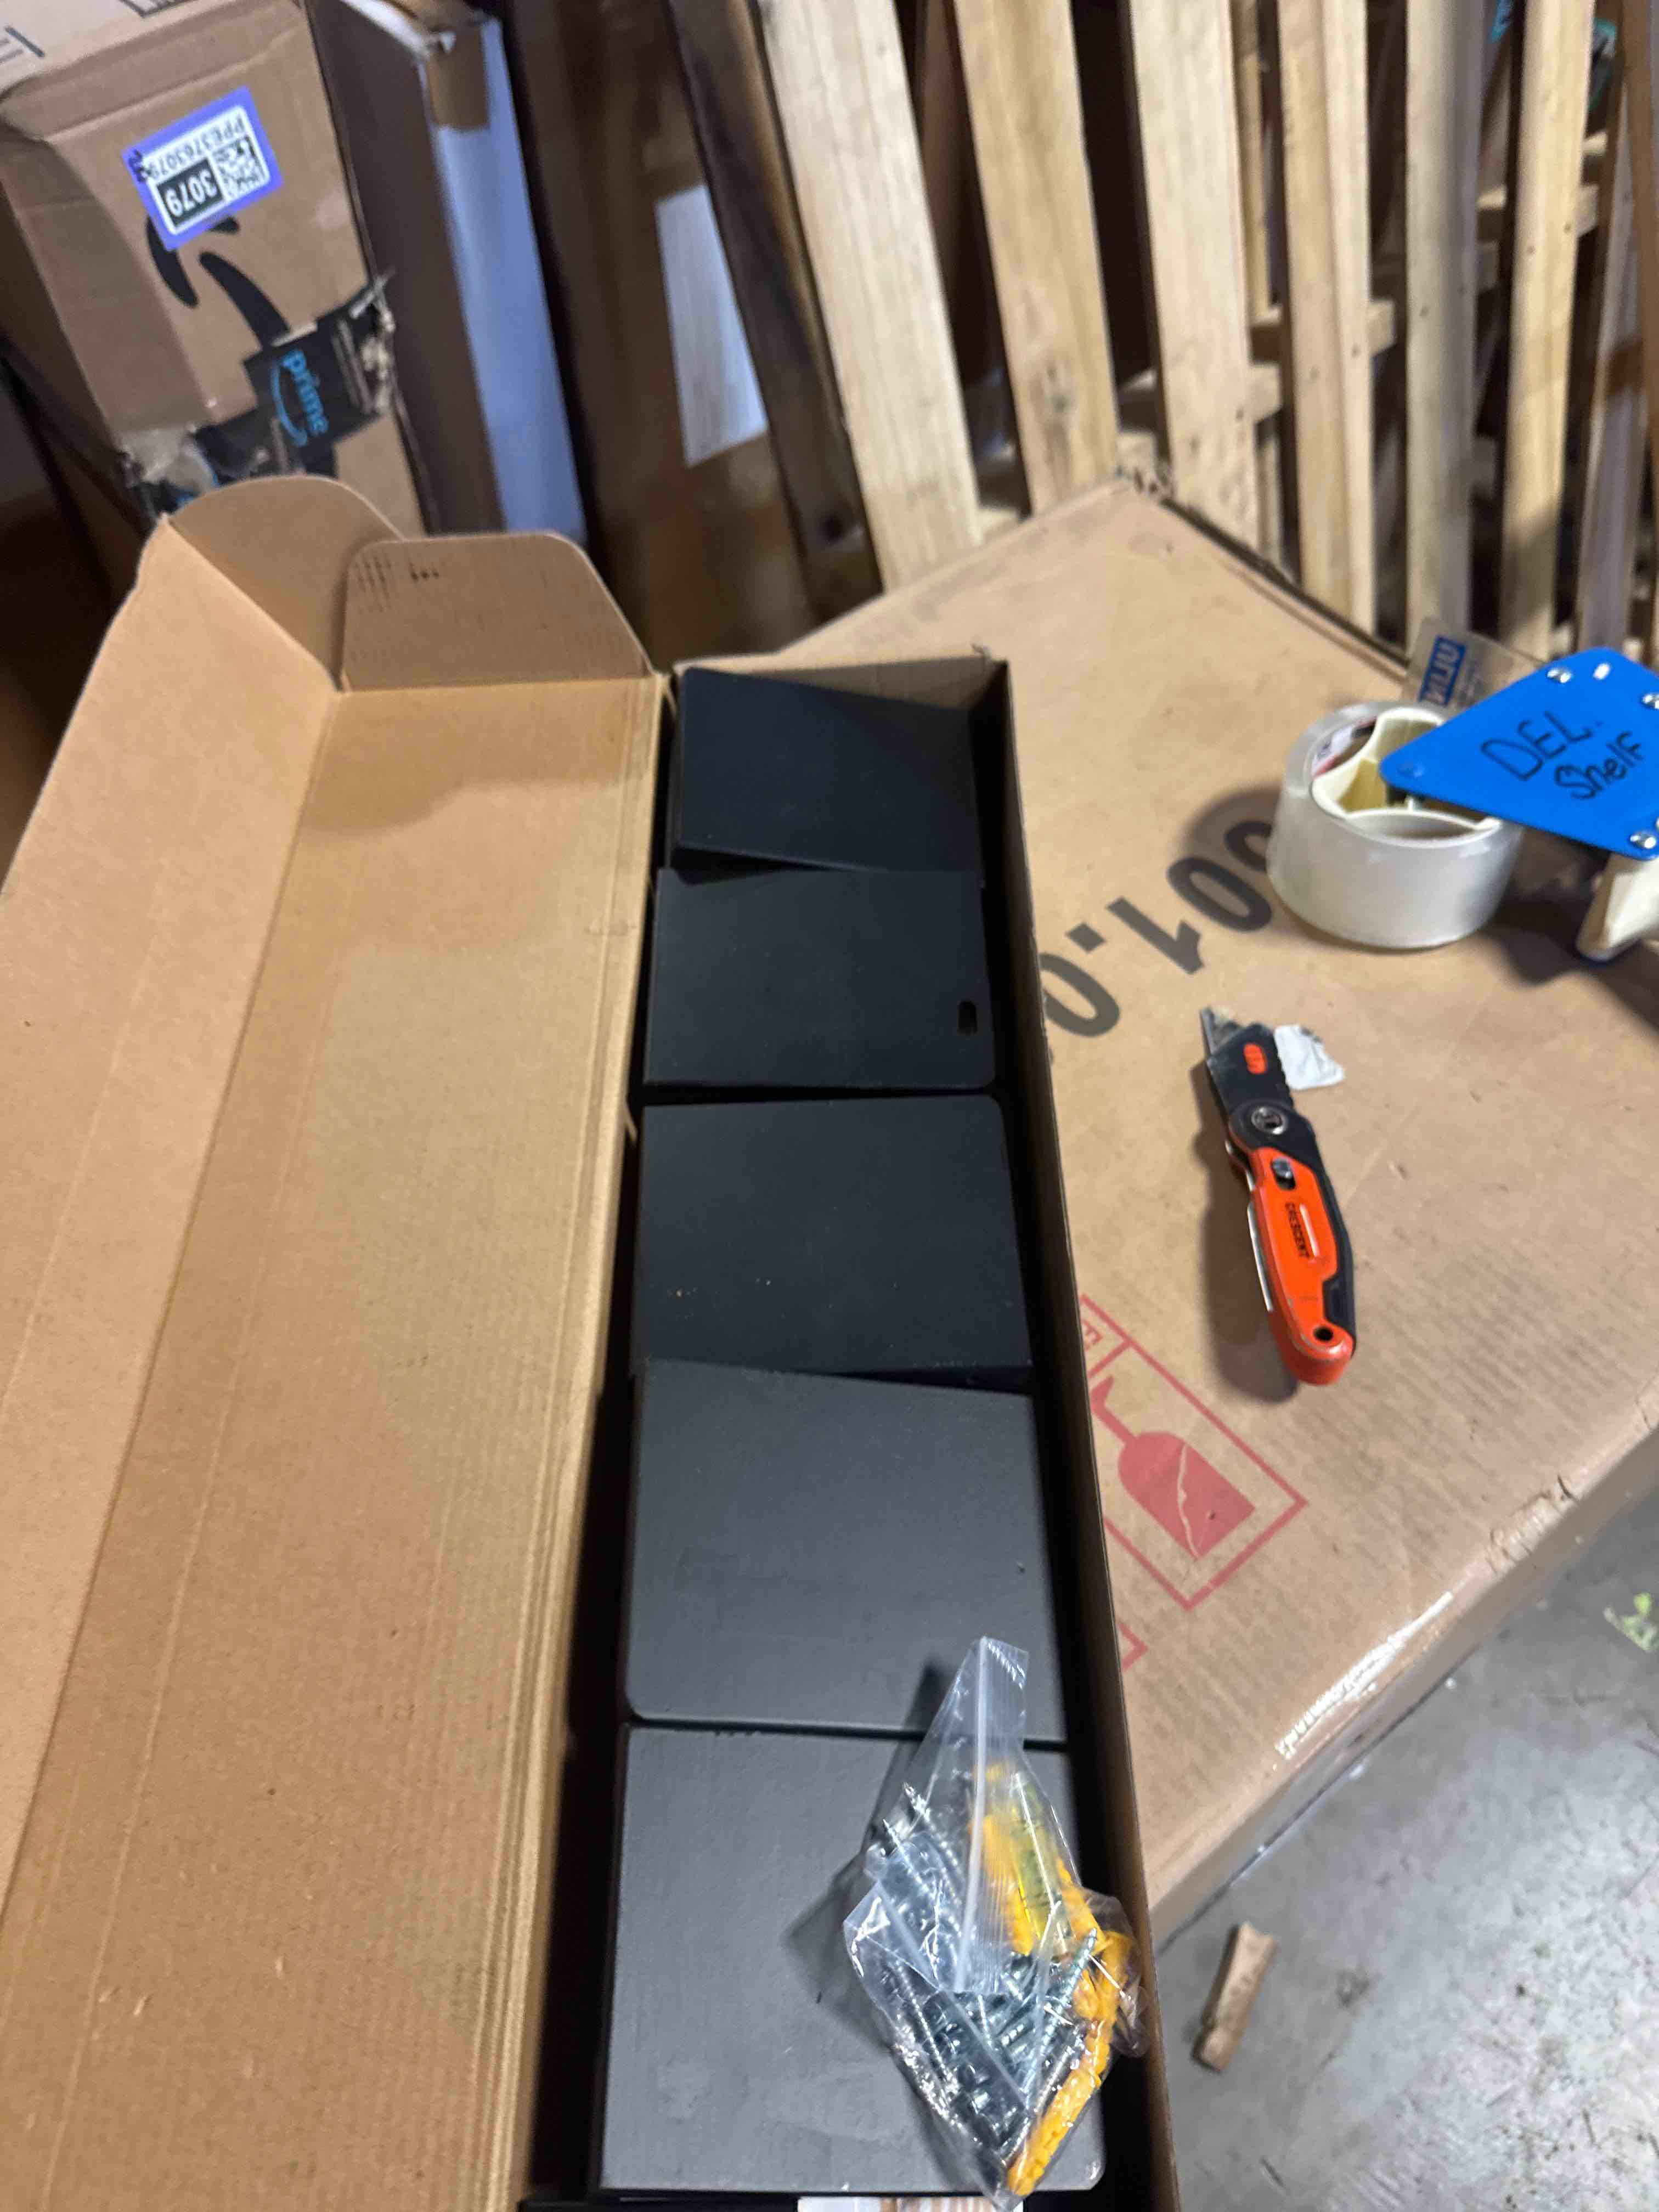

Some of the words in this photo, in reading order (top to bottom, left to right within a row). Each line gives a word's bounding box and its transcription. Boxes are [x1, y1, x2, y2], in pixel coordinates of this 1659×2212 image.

[166, 169, 218, 217] 3079
[280, 349, 329, 437] prime
[1285, 1202, 1310, 1258] CRESCENT
